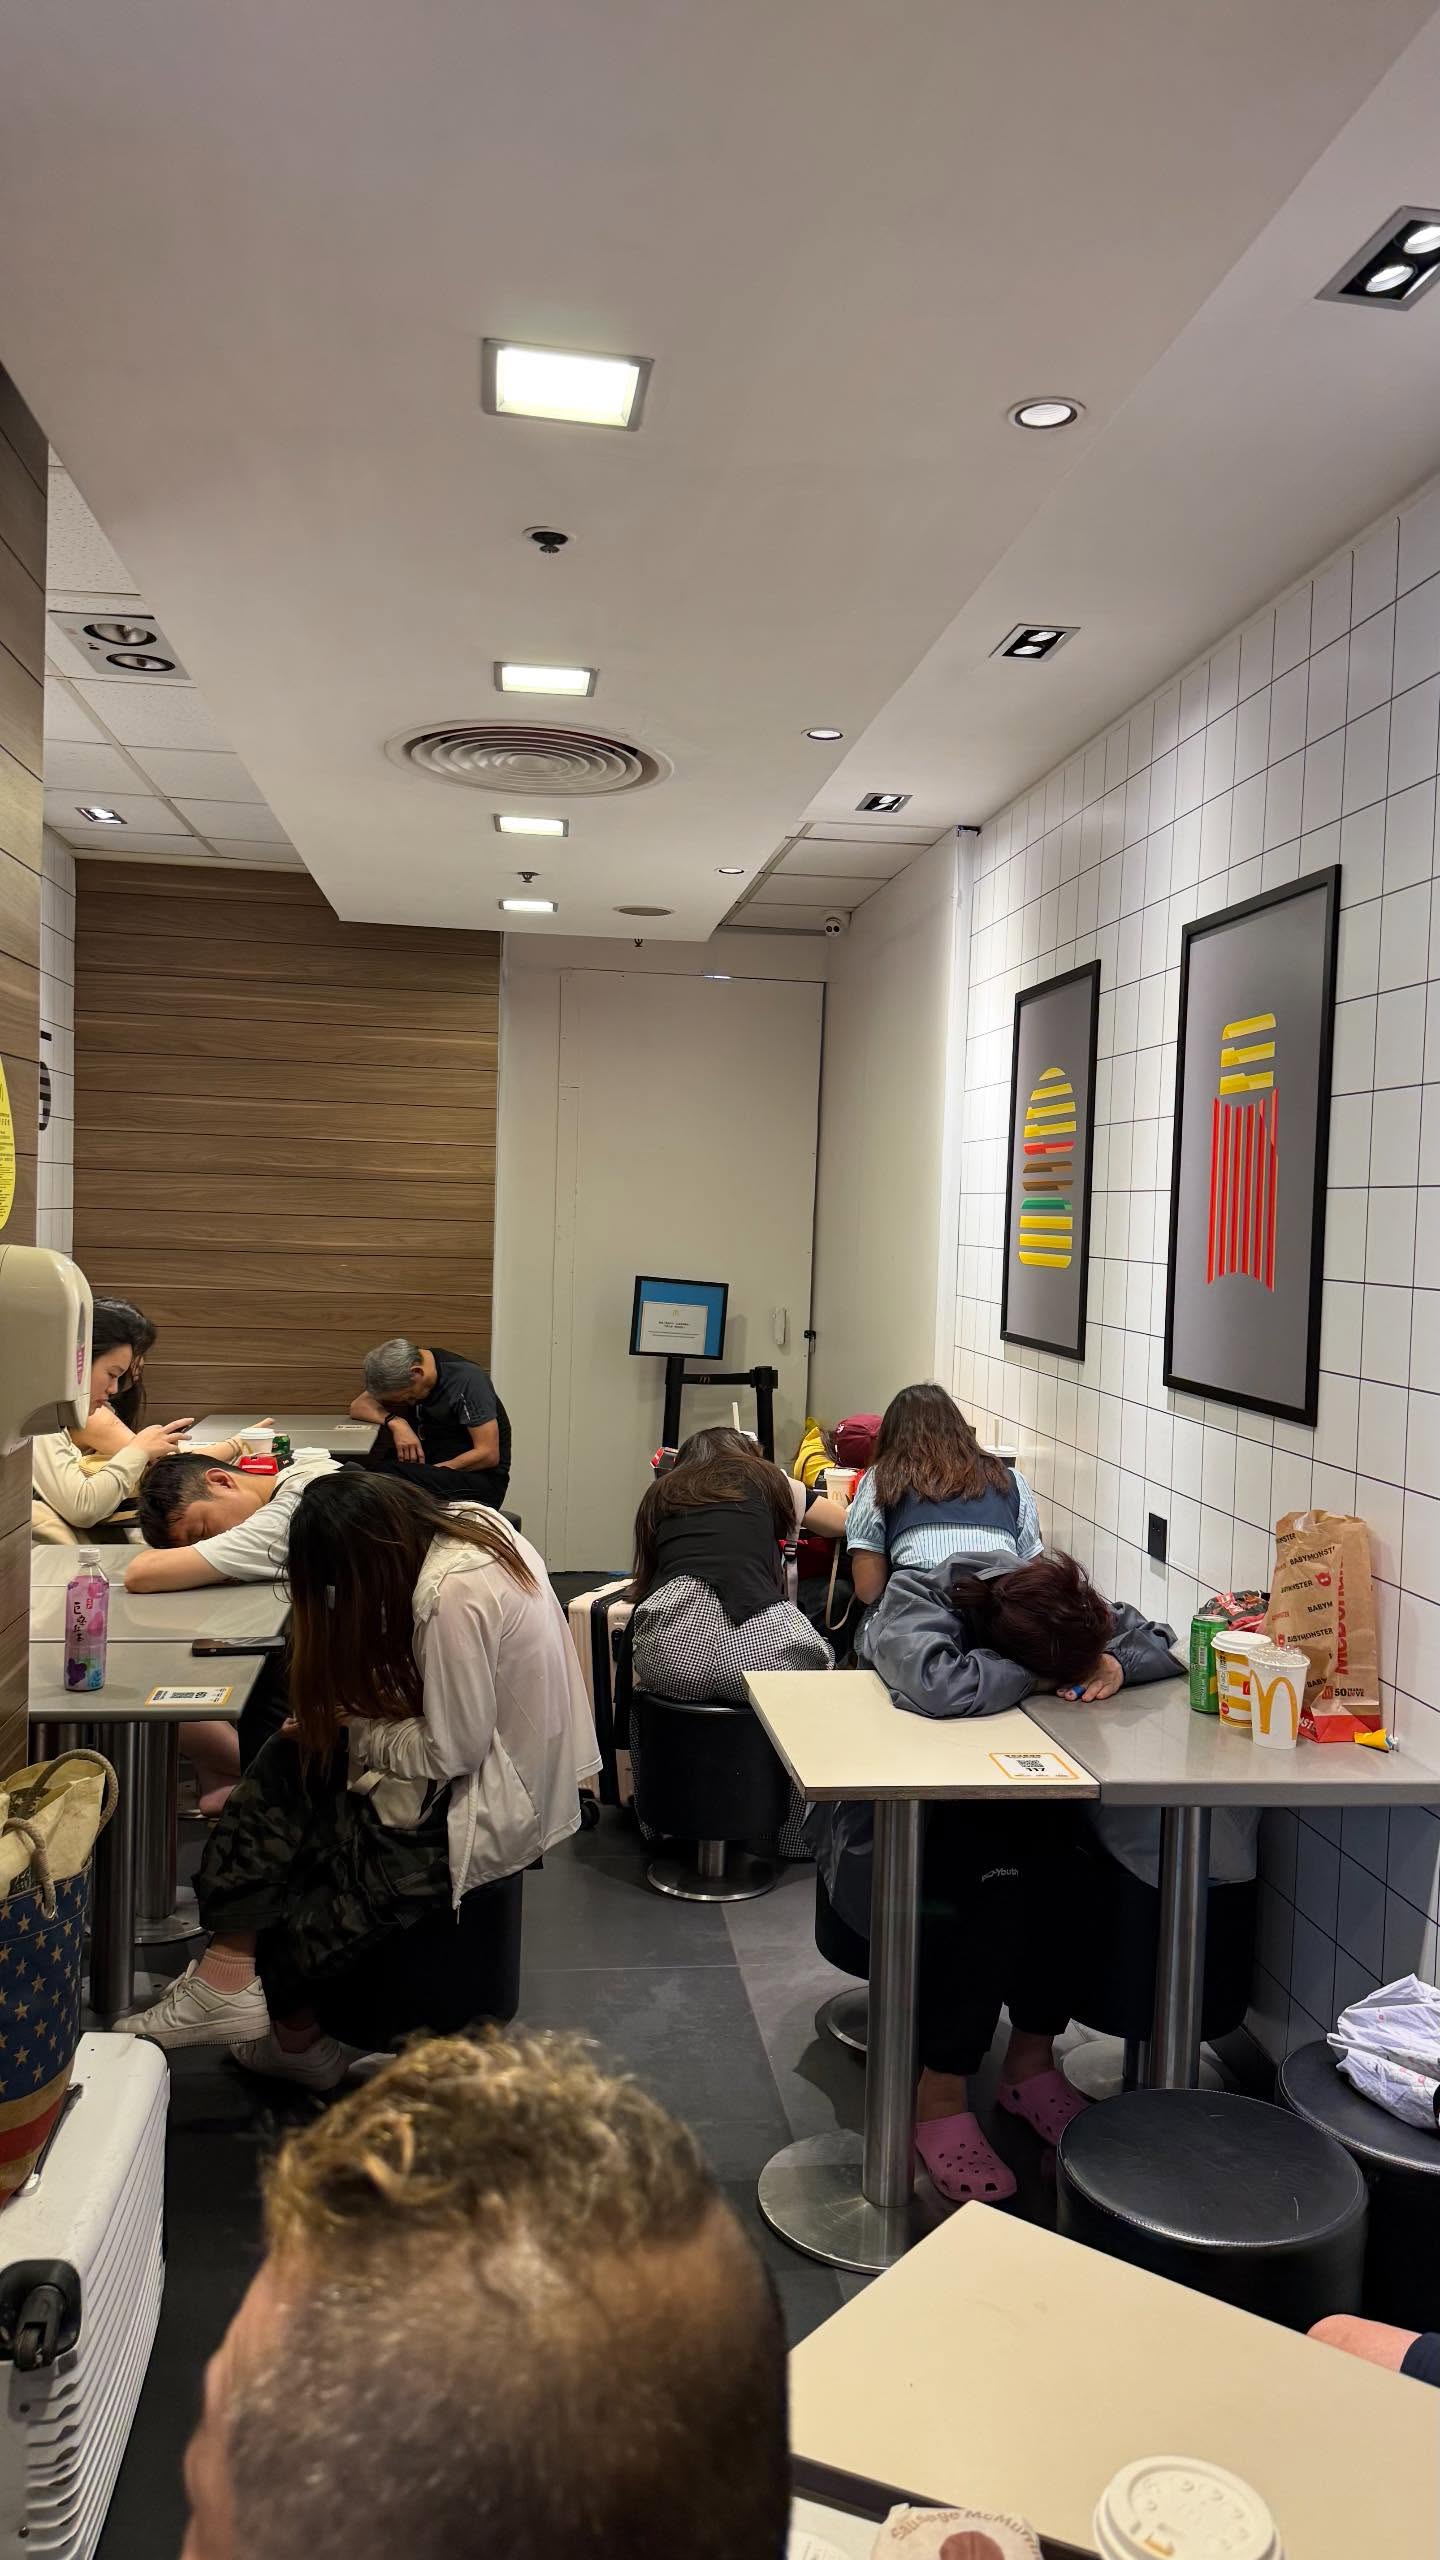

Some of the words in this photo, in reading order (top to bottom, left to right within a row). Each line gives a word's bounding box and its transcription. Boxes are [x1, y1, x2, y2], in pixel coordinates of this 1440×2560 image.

[1287, 1627, 1333, 1643] BABYMONSTER
[1334, 1688, 1347, 1697] 50
[891, 2510, 960, 2541] Sausage
